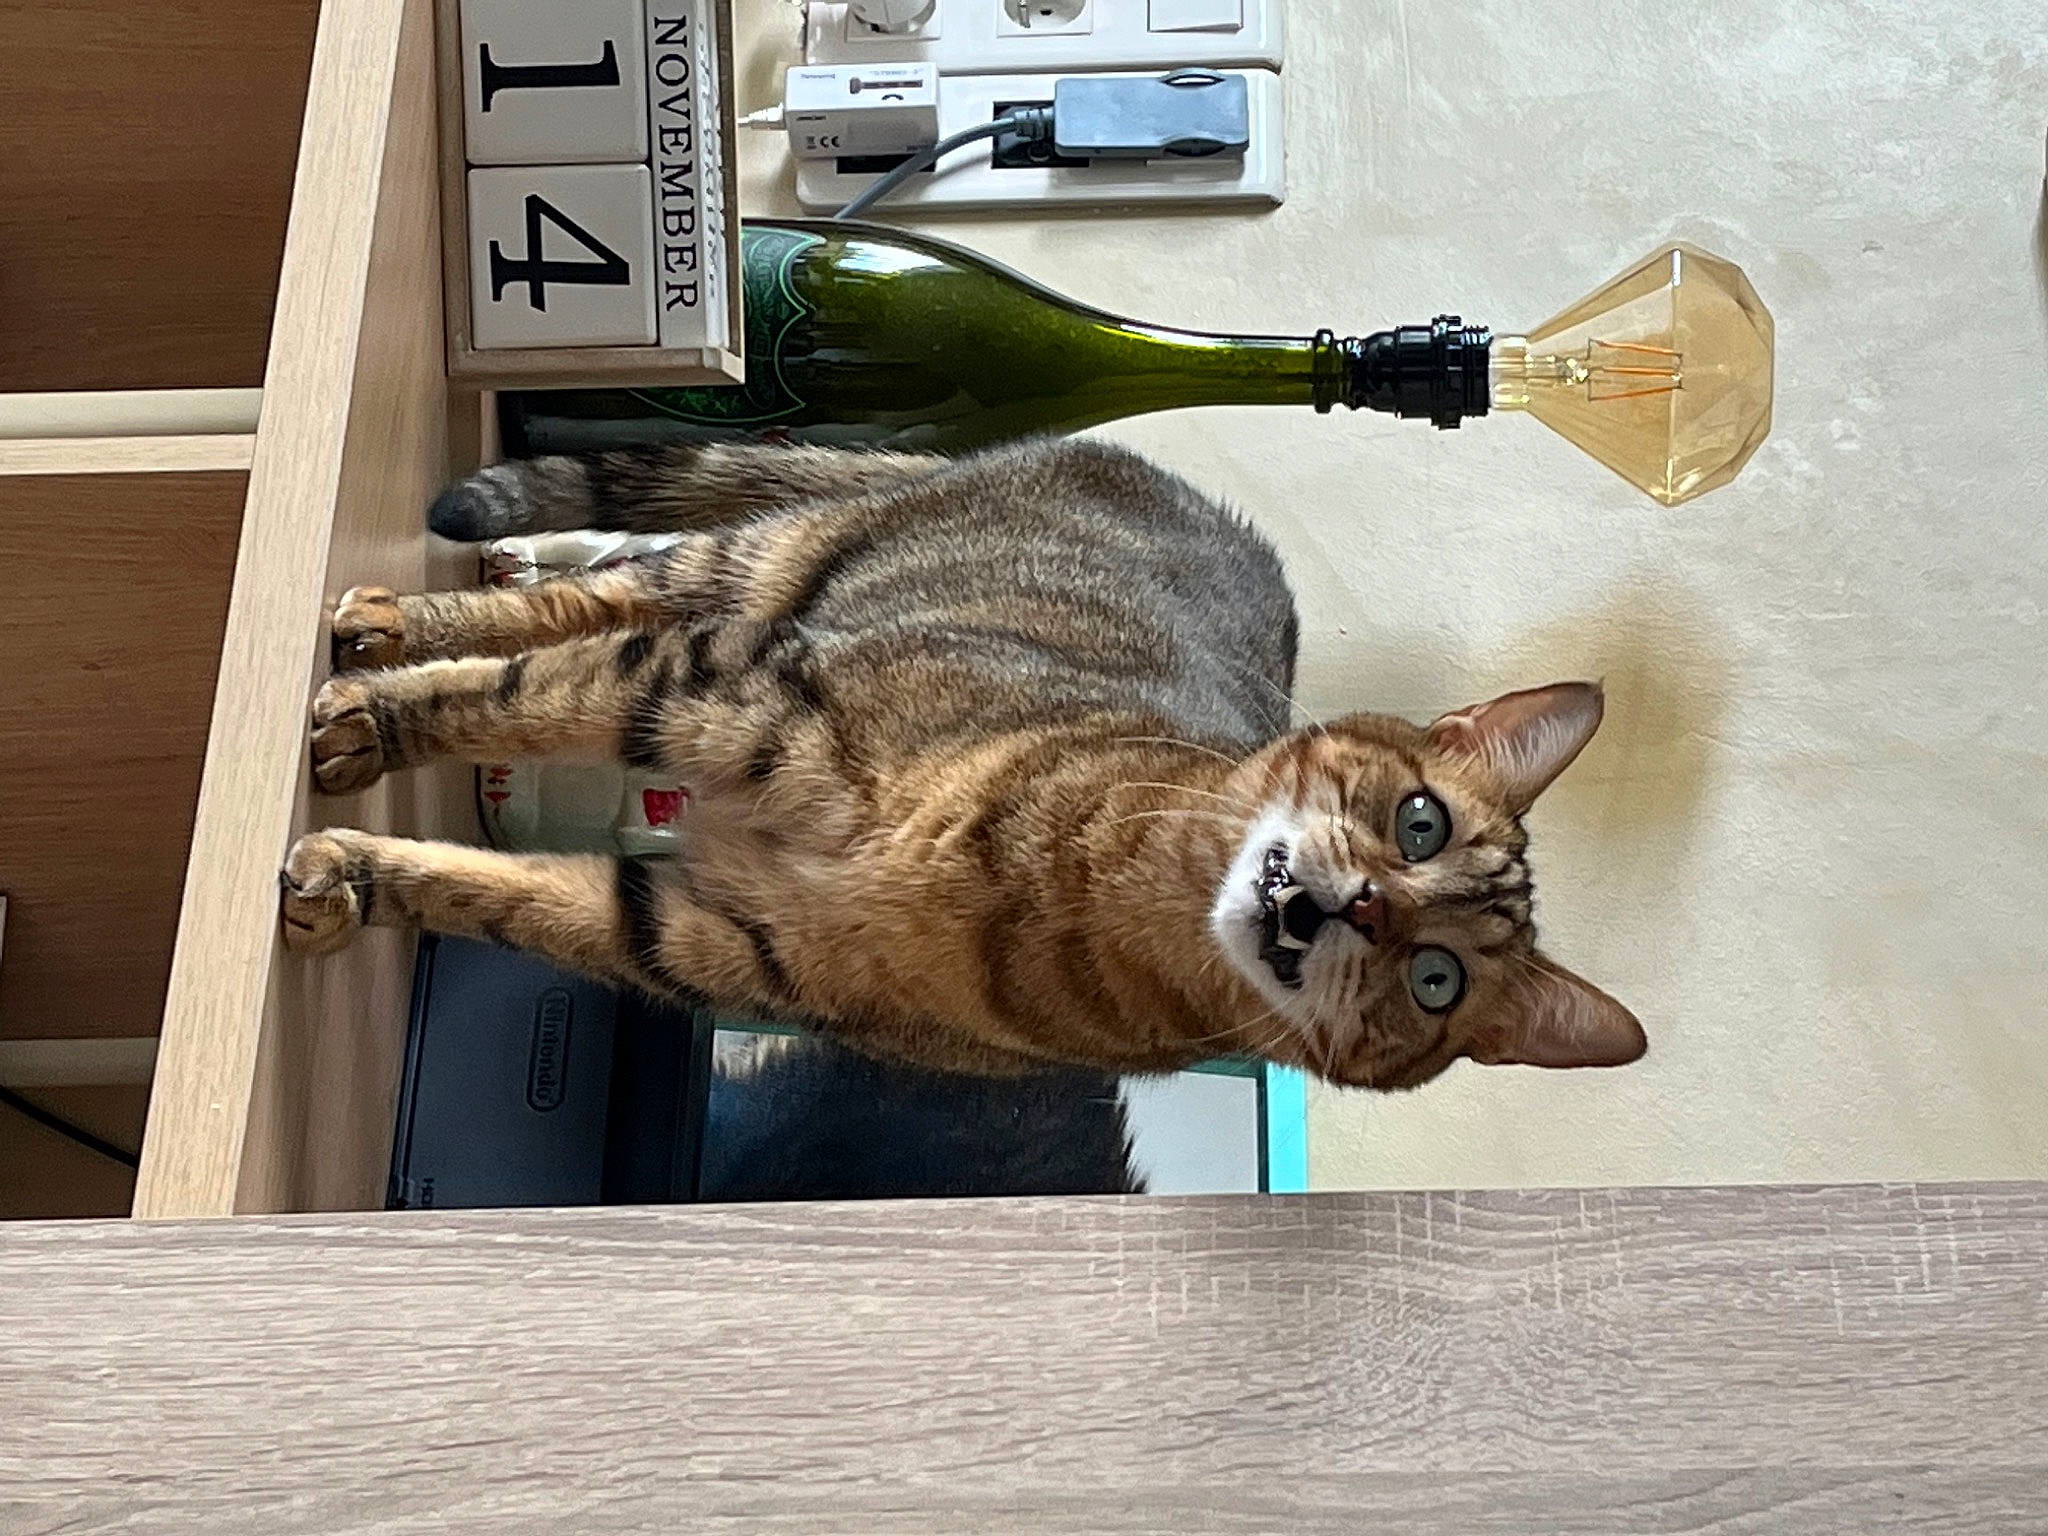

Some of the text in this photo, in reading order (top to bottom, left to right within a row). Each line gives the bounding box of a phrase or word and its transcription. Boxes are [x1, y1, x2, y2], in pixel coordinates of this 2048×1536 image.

[480, 40, 630, 312] 1 4
[654, 15, 698, 311] NOVEMBER
[535, 998, 566, 1100] Nintendo
